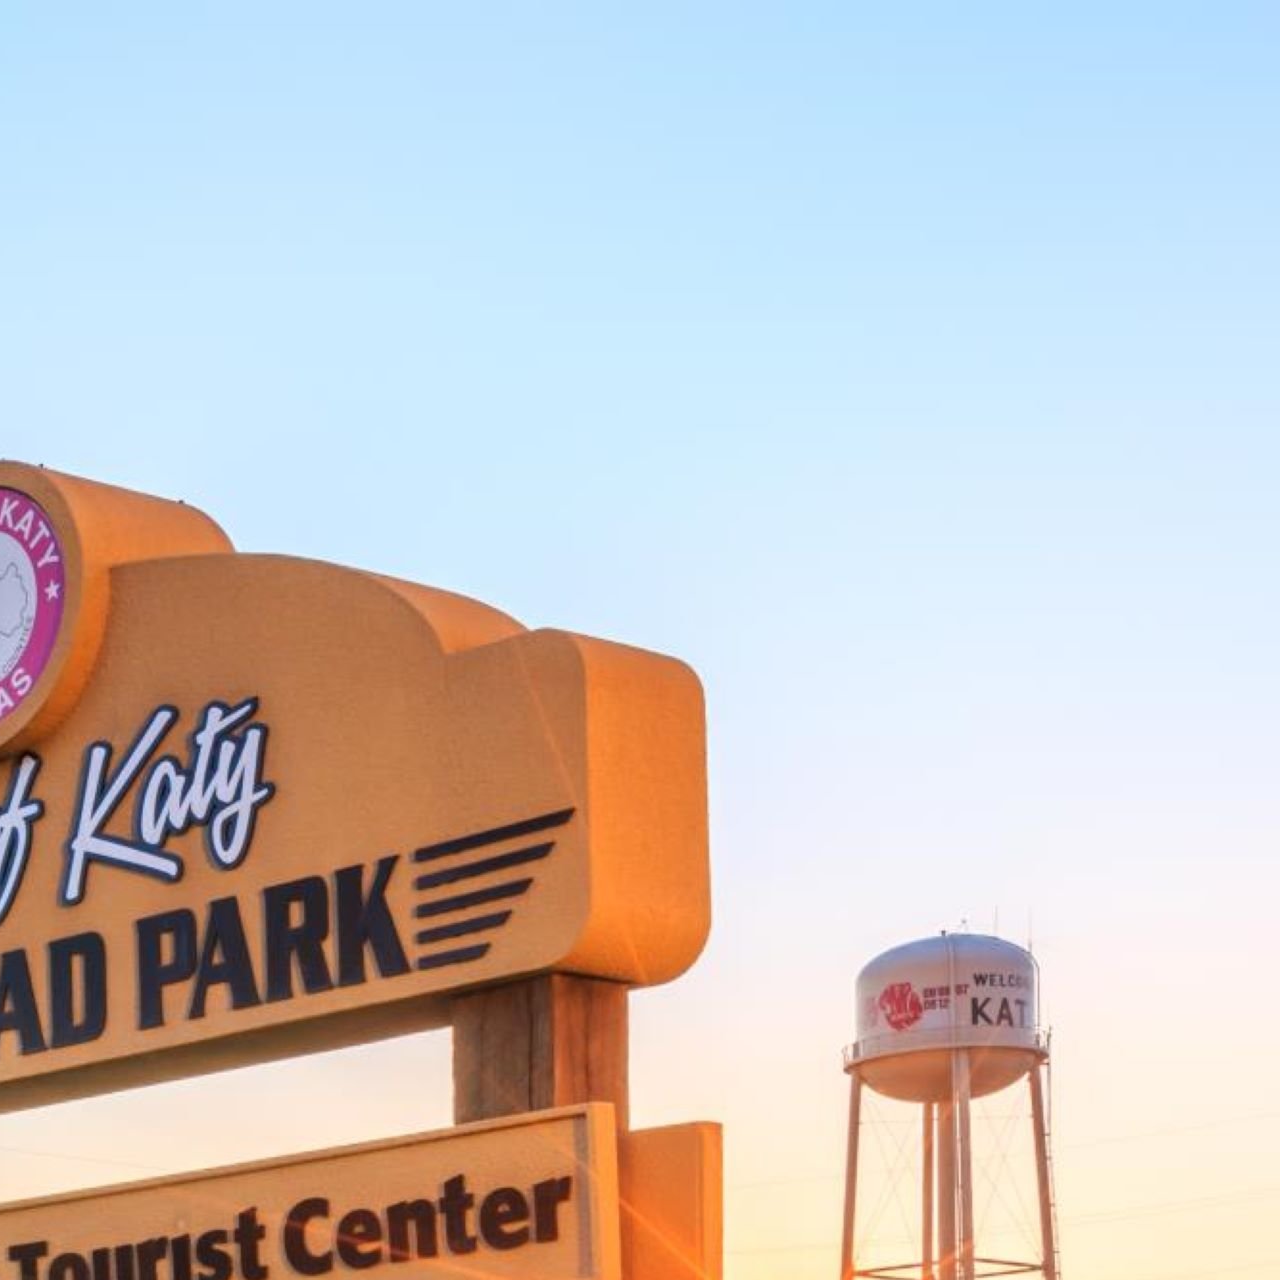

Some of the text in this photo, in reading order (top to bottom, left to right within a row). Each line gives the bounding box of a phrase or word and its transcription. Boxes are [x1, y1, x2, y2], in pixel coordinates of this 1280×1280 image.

[58, 697, 274, 907] Katy
[135, 855, 413, 1031] PARK
[283, 1173, 573, 1277] Center
